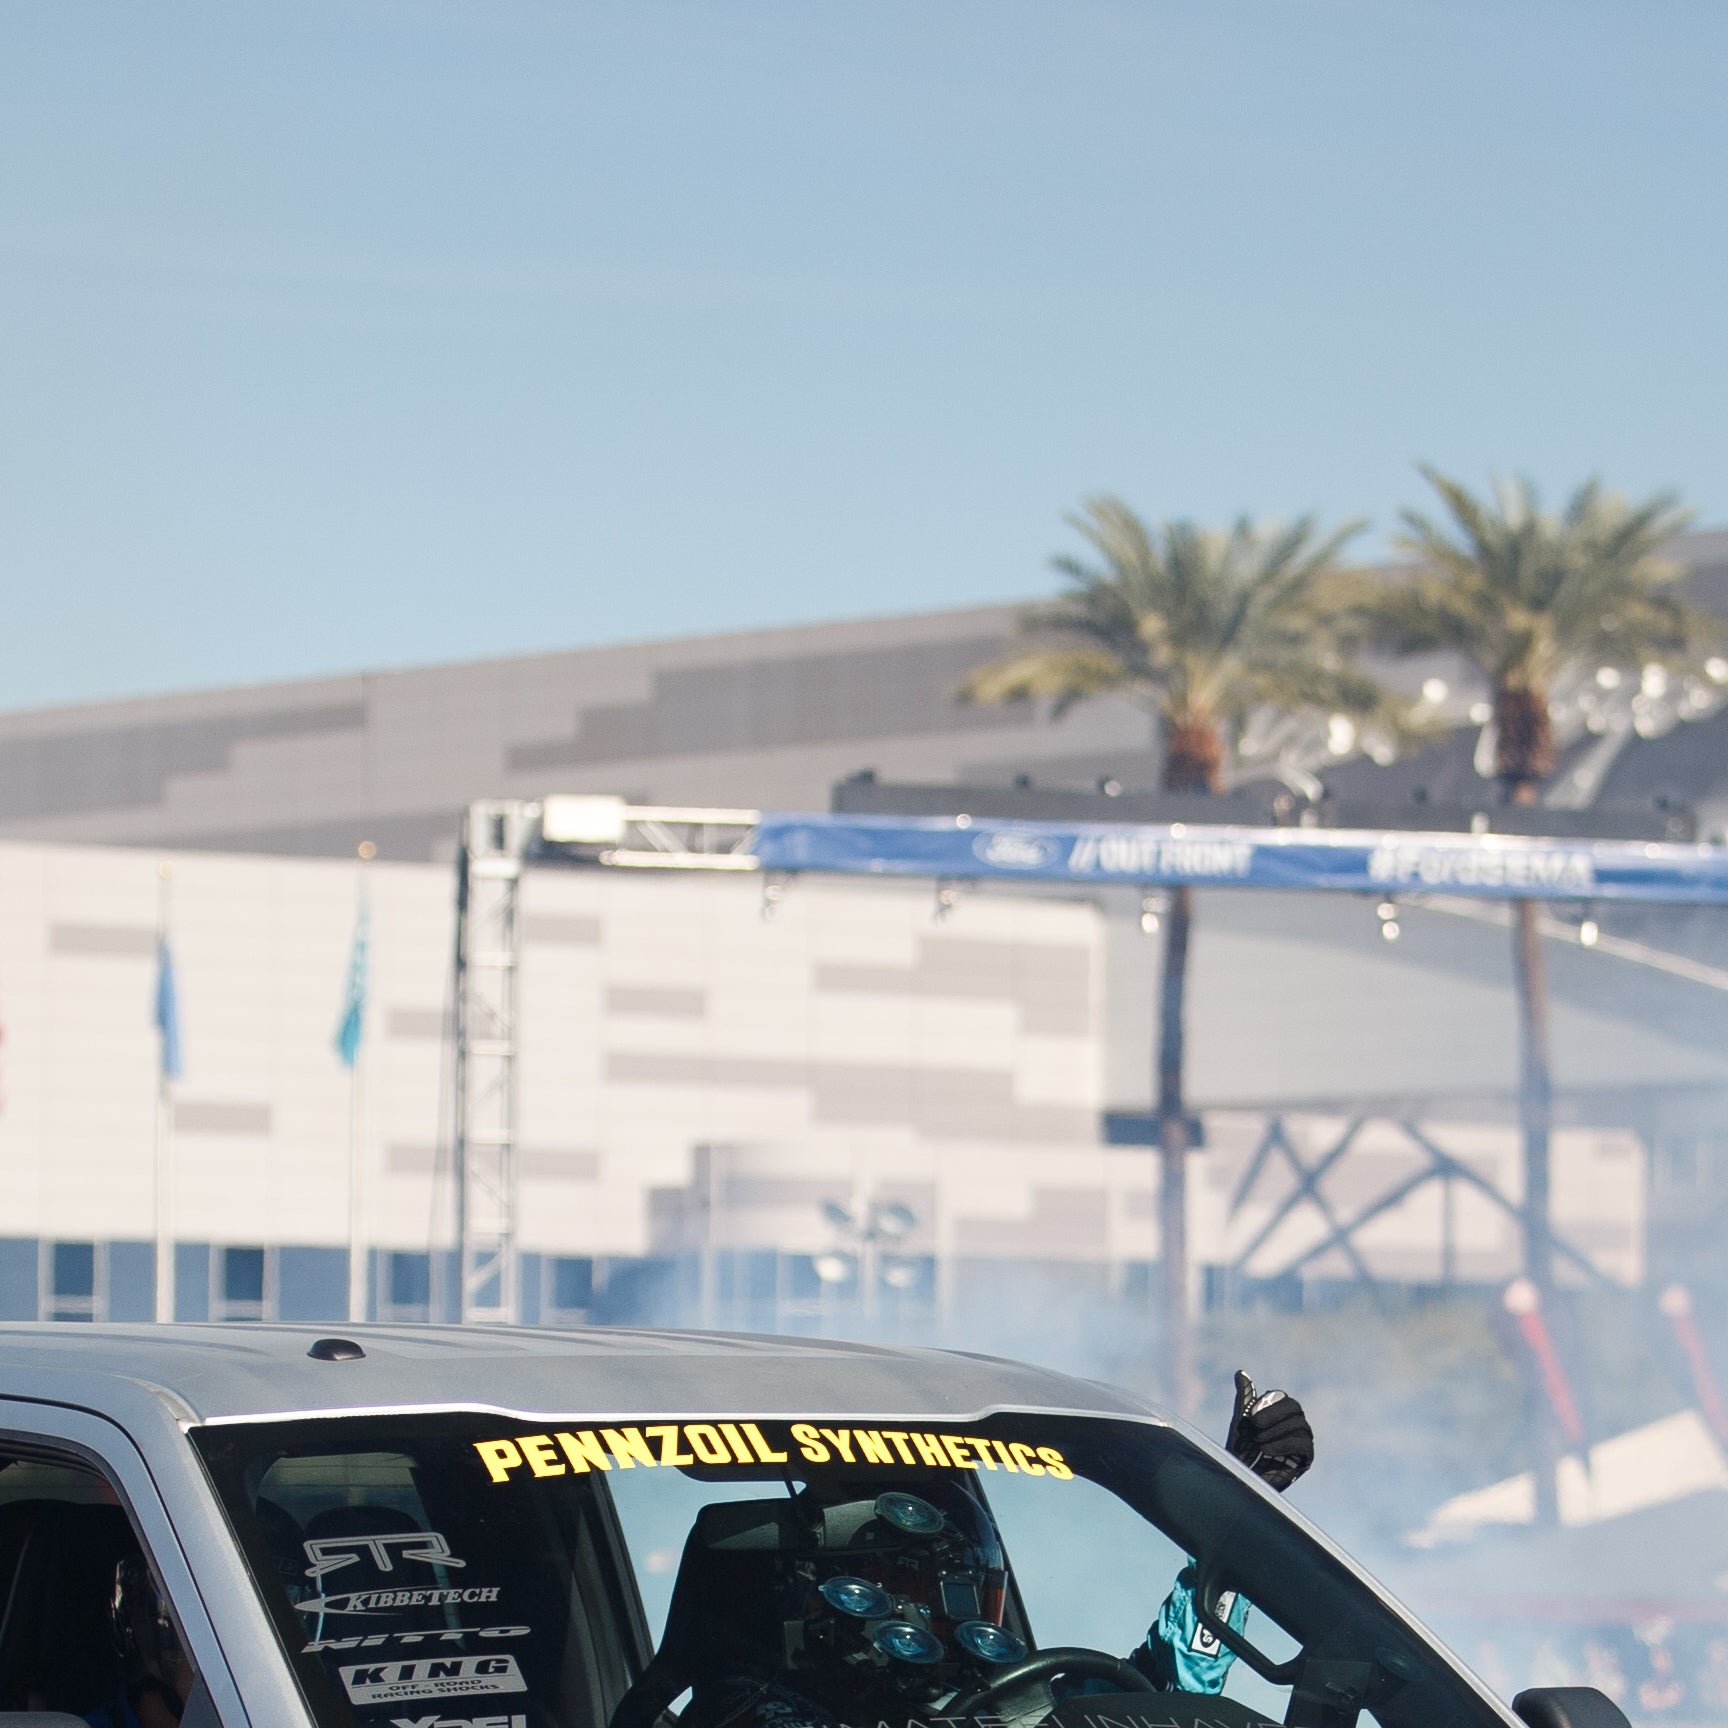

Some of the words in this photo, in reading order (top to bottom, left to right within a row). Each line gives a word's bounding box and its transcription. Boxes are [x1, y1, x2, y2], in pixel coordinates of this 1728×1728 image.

[473, 1423, 788, 1483] PENNZOIL
[792, 1423, 1074, 1481] SYNTHETICS
[343, 1586, 501, 1612] KIBBETECH
[300, 1626, 532, 1654] NITTO
[350, 1658, 512, 1686] KING
[371, 1688, 433, 1700] RACING
[436, 1683, 501, 1694] SHOCKS
